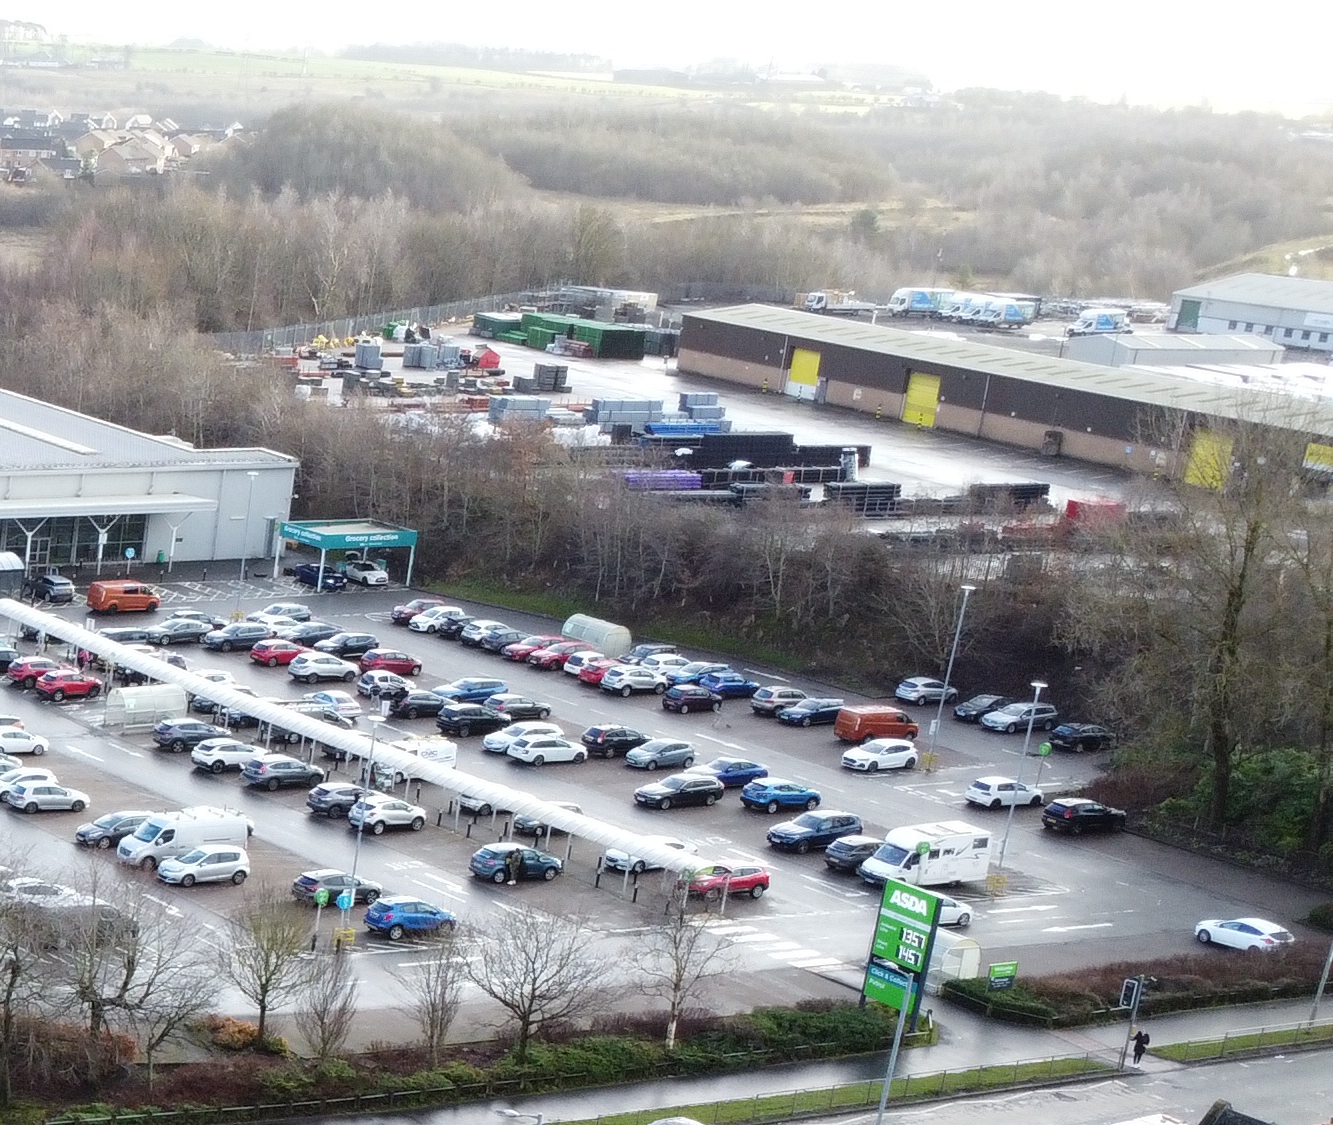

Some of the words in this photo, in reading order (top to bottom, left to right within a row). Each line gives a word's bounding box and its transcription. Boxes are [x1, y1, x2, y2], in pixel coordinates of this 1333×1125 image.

[284, 525, 300, 537] Grocery
[890, 890, 927, 916] ASDA
[870, 967, 884, 977] Click
